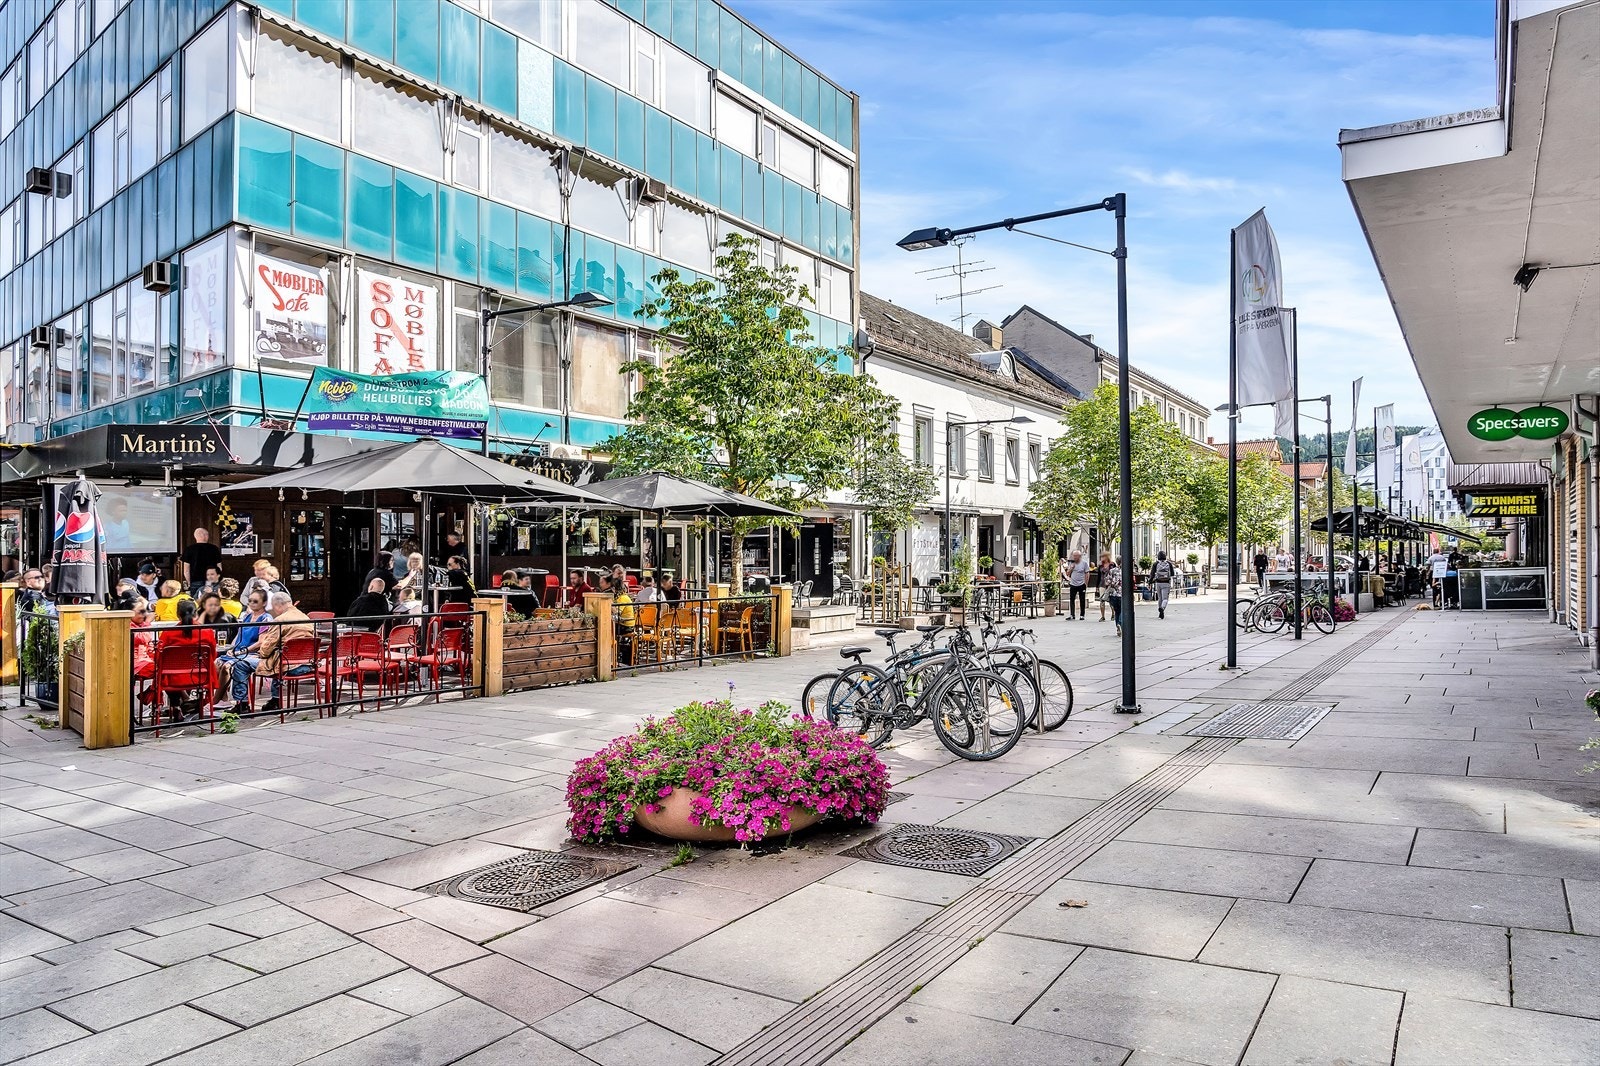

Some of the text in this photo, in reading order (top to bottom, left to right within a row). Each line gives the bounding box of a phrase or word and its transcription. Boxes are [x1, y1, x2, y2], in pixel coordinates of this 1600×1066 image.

[404, 287, 426, 372] MØBLE
[318, 380, 358, 395] Nebben
[363, 393, 432, 407] HELLBILLIES
[441, 398, 484, 411] MADCON
[310, 413, 330, 421] KJØP
[331, 413, 370, 421] BILLETTER
[371, 413, 384, 422] PÅ:
[385, 416, 486, 429] WWW.NEBBENFESTIVALEN.NO
[1476, 418, 1559, 431] Specsavers
[120, 433, 217, 454] Martin's
[1472, 495, 1537, 506] BETONMAST
[1499, 505, 1537, 515] HÆHRE
[61, 549, 95, 563] MAX
